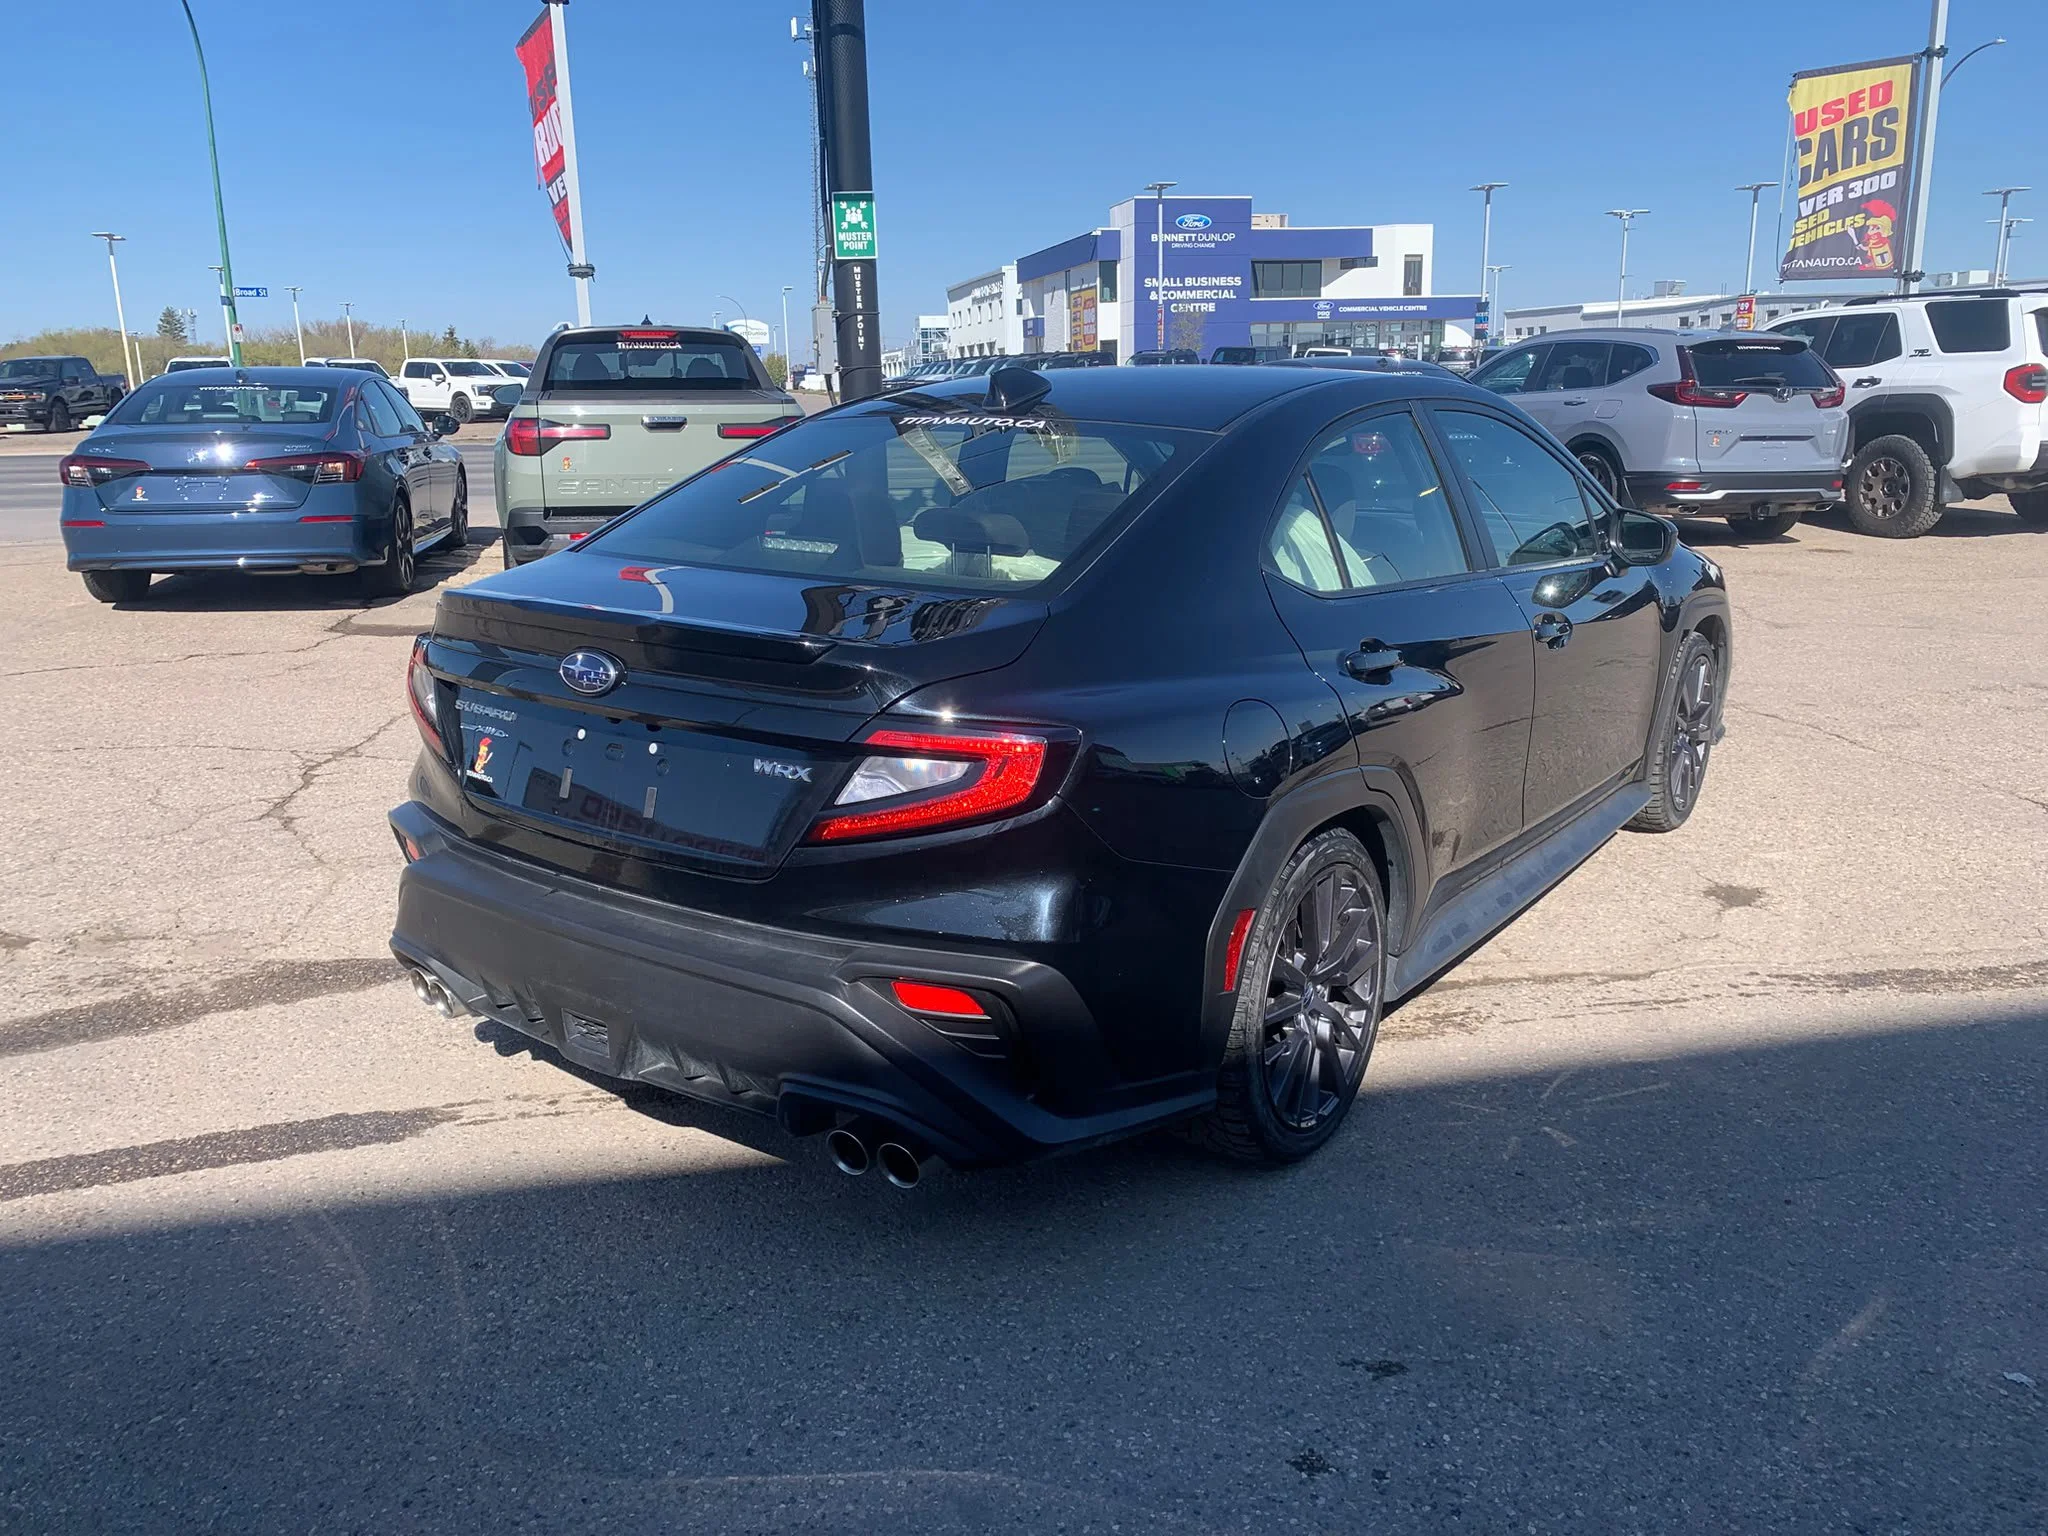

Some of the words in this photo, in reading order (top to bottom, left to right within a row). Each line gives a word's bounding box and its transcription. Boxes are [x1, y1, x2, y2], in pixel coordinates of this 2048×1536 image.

[1795, 80, 1893, 137] USED
[1799, 185, 1844, 217] VER
[1848, 171, 1897, 199] 300
[1795, 208, 1830, 234] SED
[838, 232, 873, 241] MUSTER
[1198, 233, 1236, 242] DUNLOP
[843, 241, 868, 250] POINT
[1782, 257, 1862, 271] TITANAUTO.CA
[853, 266, 863, 309] MUSTER
[1185, 277, 1242, 286] BUSINESS
[1149, 291, 1158, 300] &
[1162, 290, 1236, 300] COMMERCIAL
[1170, 303, 1216, 312] CENTRE
[857, 315, 865, 350] POINT
[616, 341, 682, 349] TITANAUTO.CA
[900, 416, 1046, 429] TITANAUTO.CA
[455, 699, 517, 722] SUBARU
[754, 757, 812, 783] WRX
